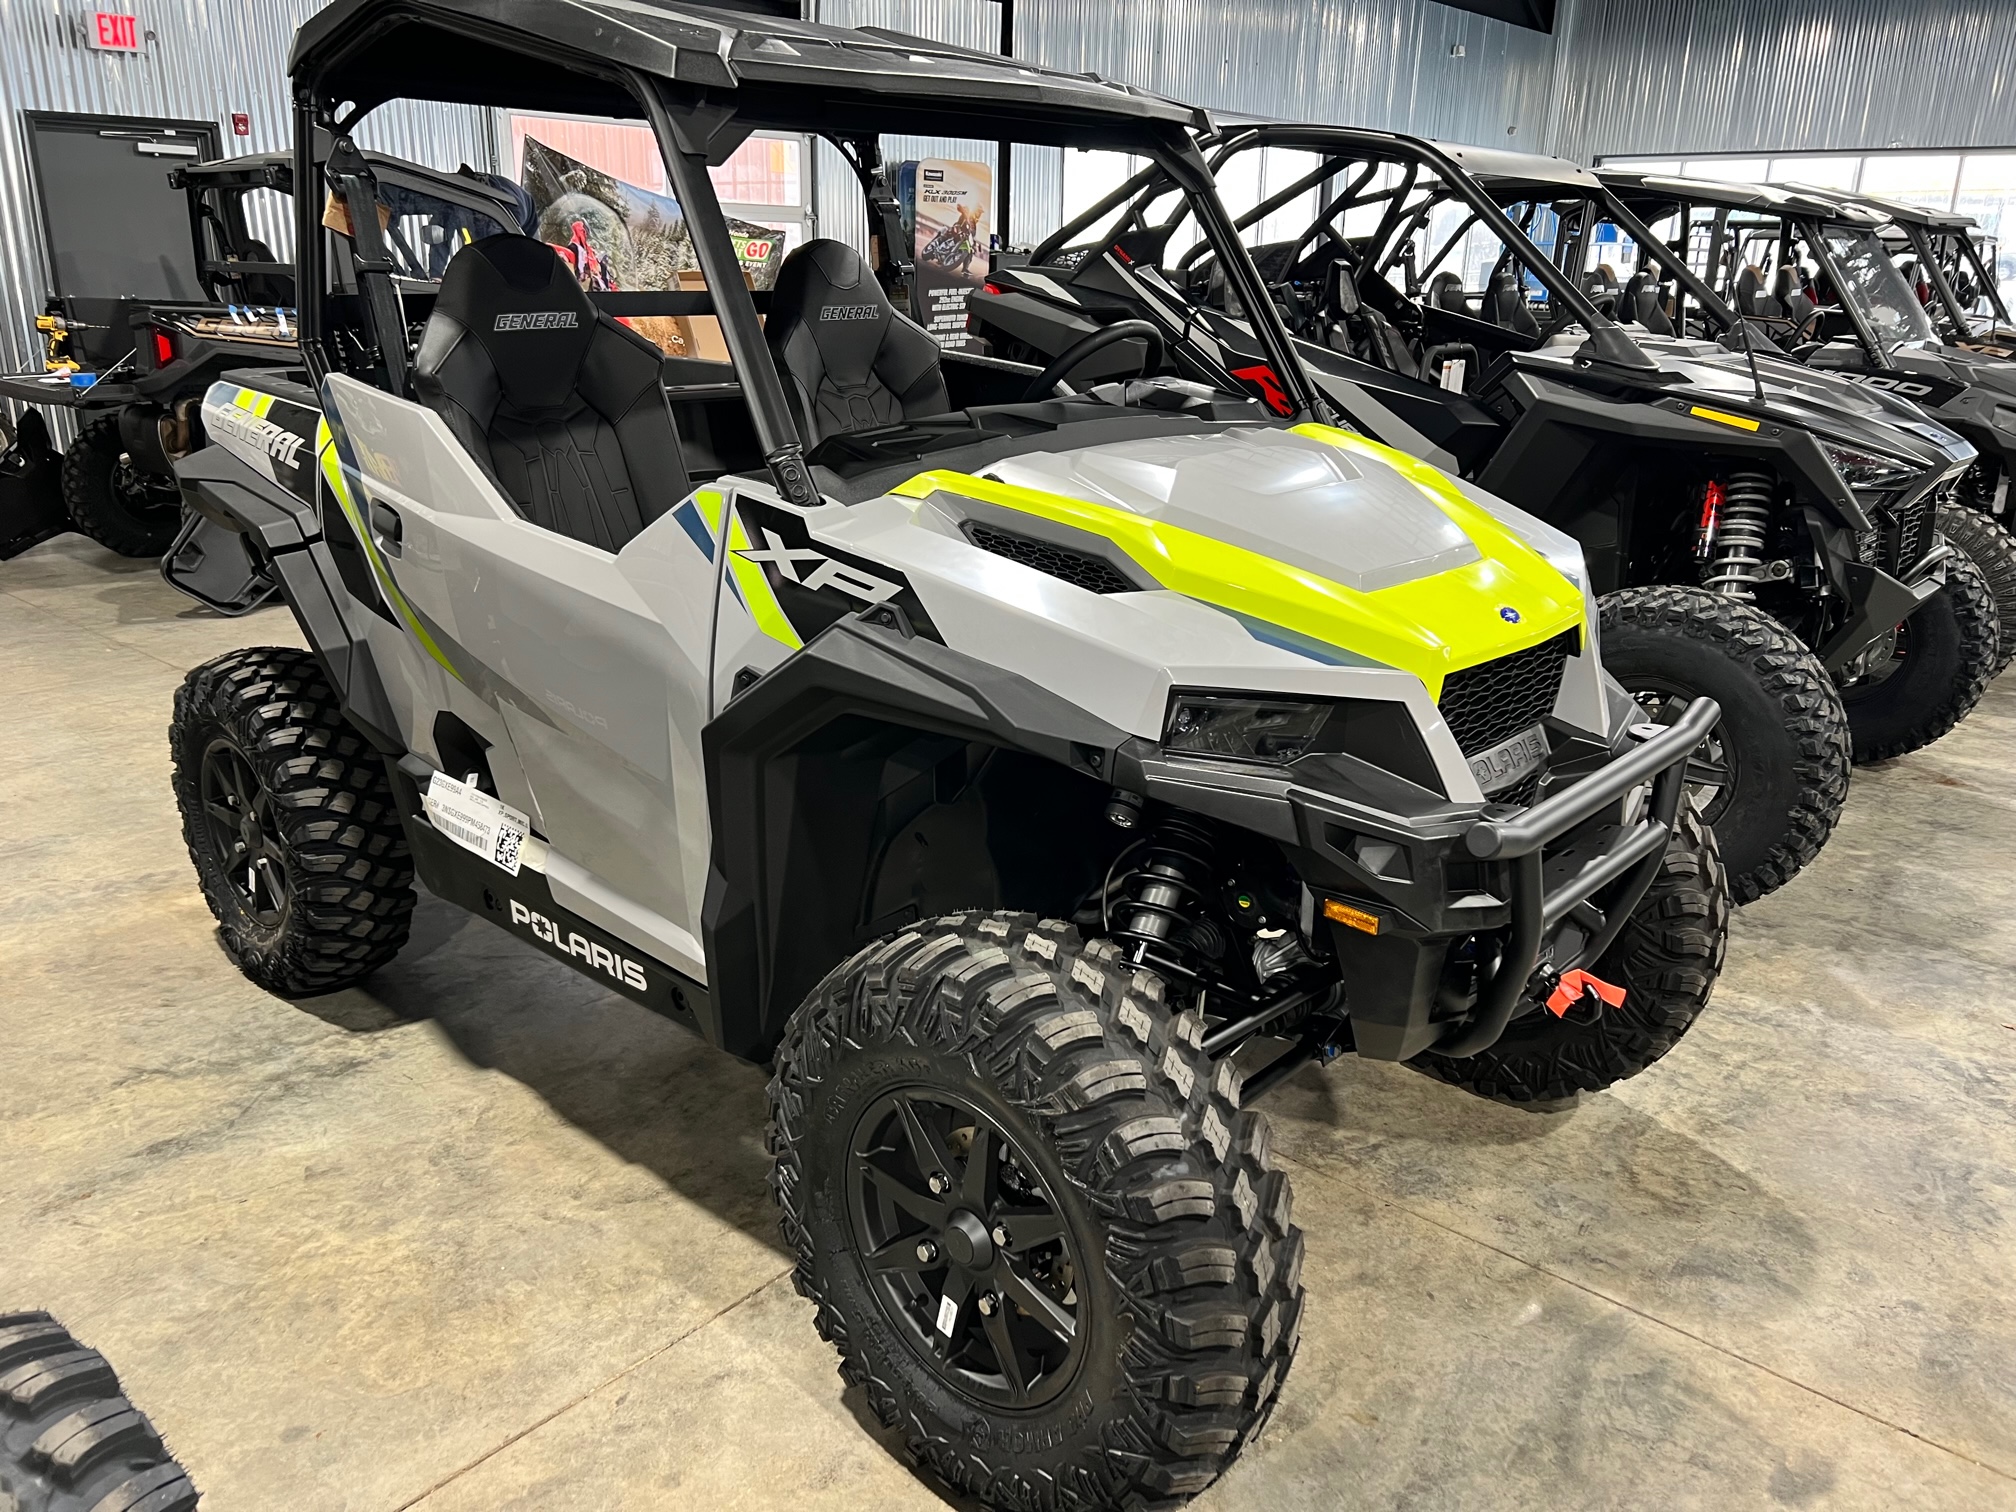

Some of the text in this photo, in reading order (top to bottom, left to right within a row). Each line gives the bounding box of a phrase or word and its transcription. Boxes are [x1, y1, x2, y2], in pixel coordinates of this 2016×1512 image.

[96, 13, 137, 48] EXIT
[947, 196, 957, 204] PLAY
[746, 241, 770, 259] GO
[493, 311, 579, 331] GENERAL
[819, 304, 880, 321] GENERAL
[210, 402, 306, 470] GENERAL
[735, 526, 904, 605] XP
[1472, 733, 1545, 785] OLARIS
[509, 898, 648, 992] POLARIS
